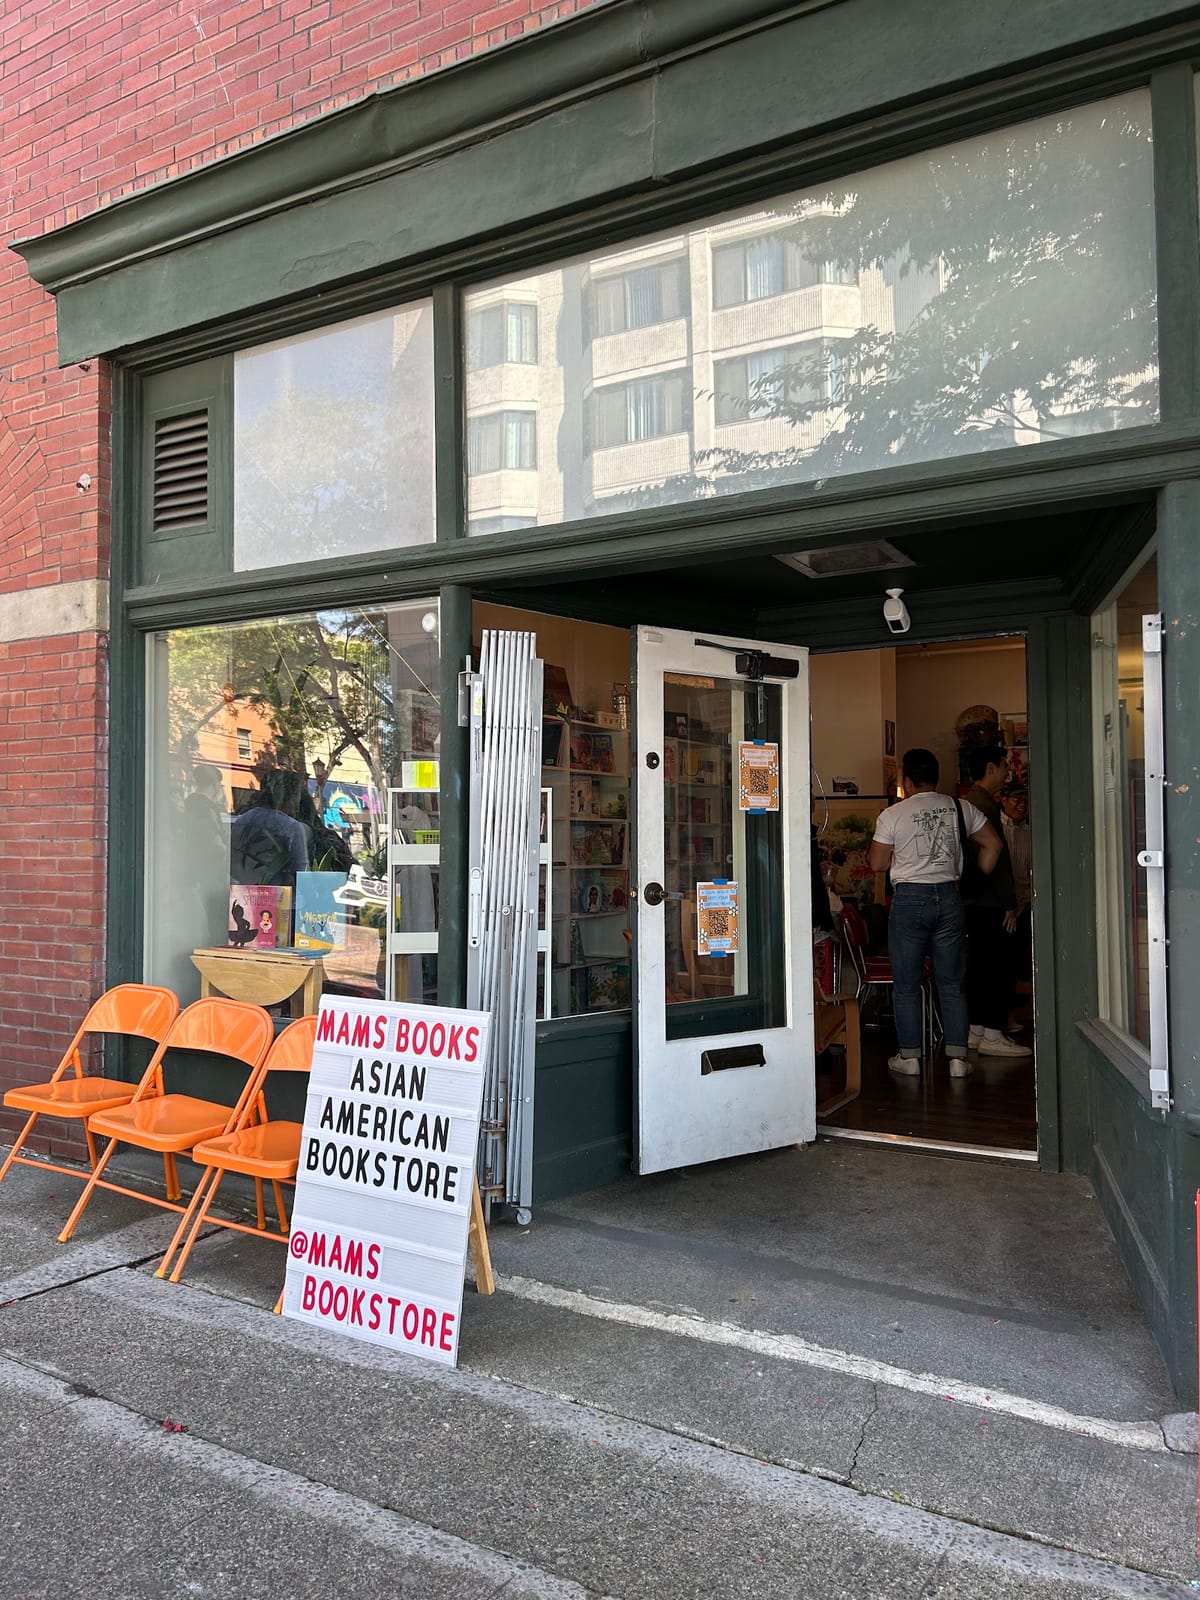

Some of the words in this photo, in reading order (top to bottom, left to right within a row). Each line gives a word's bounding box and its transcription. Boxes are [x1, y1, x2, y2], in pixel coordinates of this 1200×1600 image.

[317, 1009, 387, 1049] MAMS
[396, 1018, 479, 1062] BOOKS
[351, 1059, 426, 1101] ASIAN
[321, 1097, 449, 1153] AMERICAN
[306, 1137, 458, 1203] BOOKSTORE
[290, 1230, 381, 1279] @MAMS
[303, 1275, 455, 1352] BOOKSTORE
